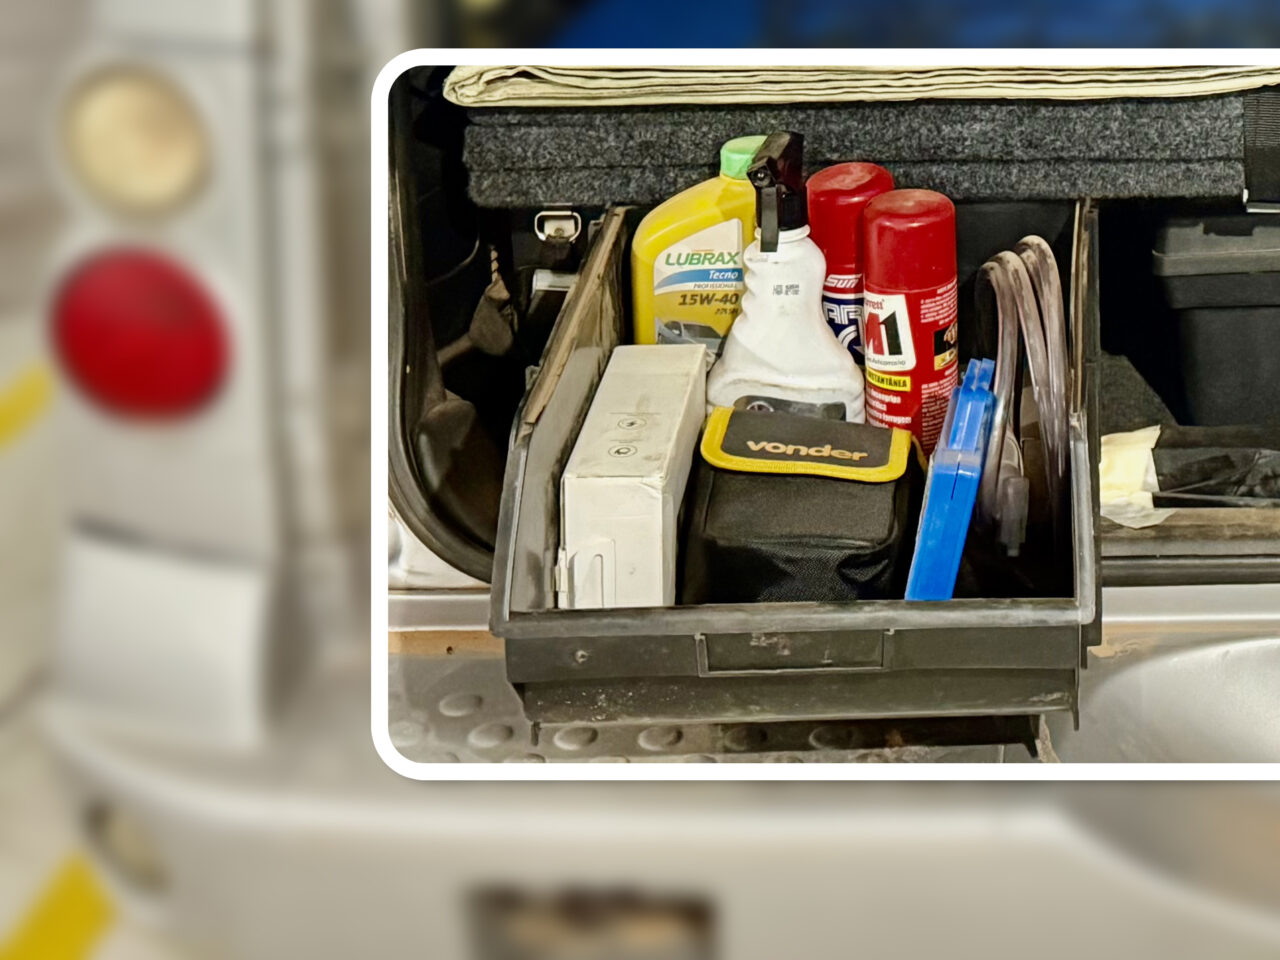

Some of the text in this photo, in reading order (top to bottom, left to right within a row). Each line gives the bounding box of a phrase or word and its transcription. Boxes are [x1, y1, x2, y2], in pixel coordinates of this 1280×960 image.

[665, 252, 739, 266] LUBRAX
[709, 270, 739, 280] Tecno
[678, 293, 740, 306] 15W-40
[746, 440, 868, 460] vonder
